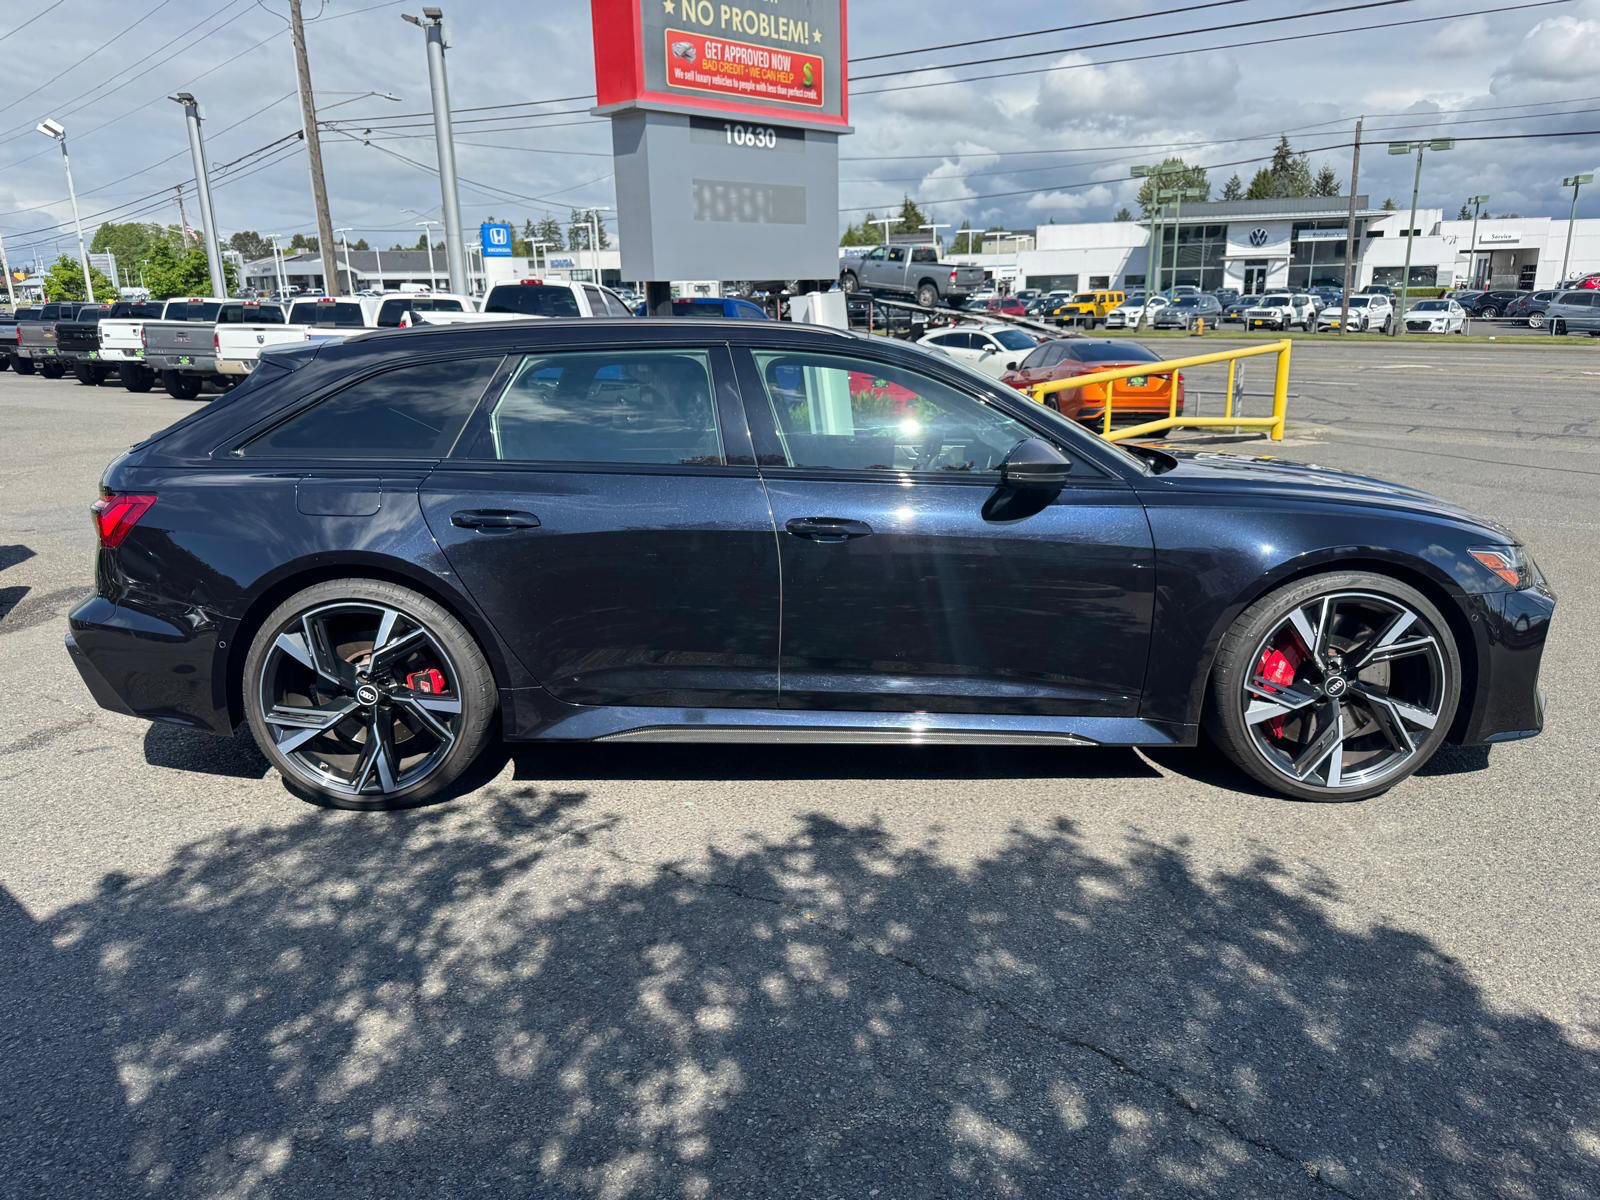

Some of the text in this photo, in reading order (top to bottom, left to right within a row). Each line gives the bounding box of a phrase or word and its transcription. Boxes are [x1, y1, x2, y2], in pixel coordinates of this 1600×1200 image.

[682, 0, 809, 45] NO PROBLEM!
[704, 41, 792, 72] GET APPROVED NOW
[674, 67, 684, 79] We
[684, 70, 695, 81] sell
[702, 59, 794, 84] BAD CREDIT WE CAN HELP
[724, 124, 776, 148] 10630
